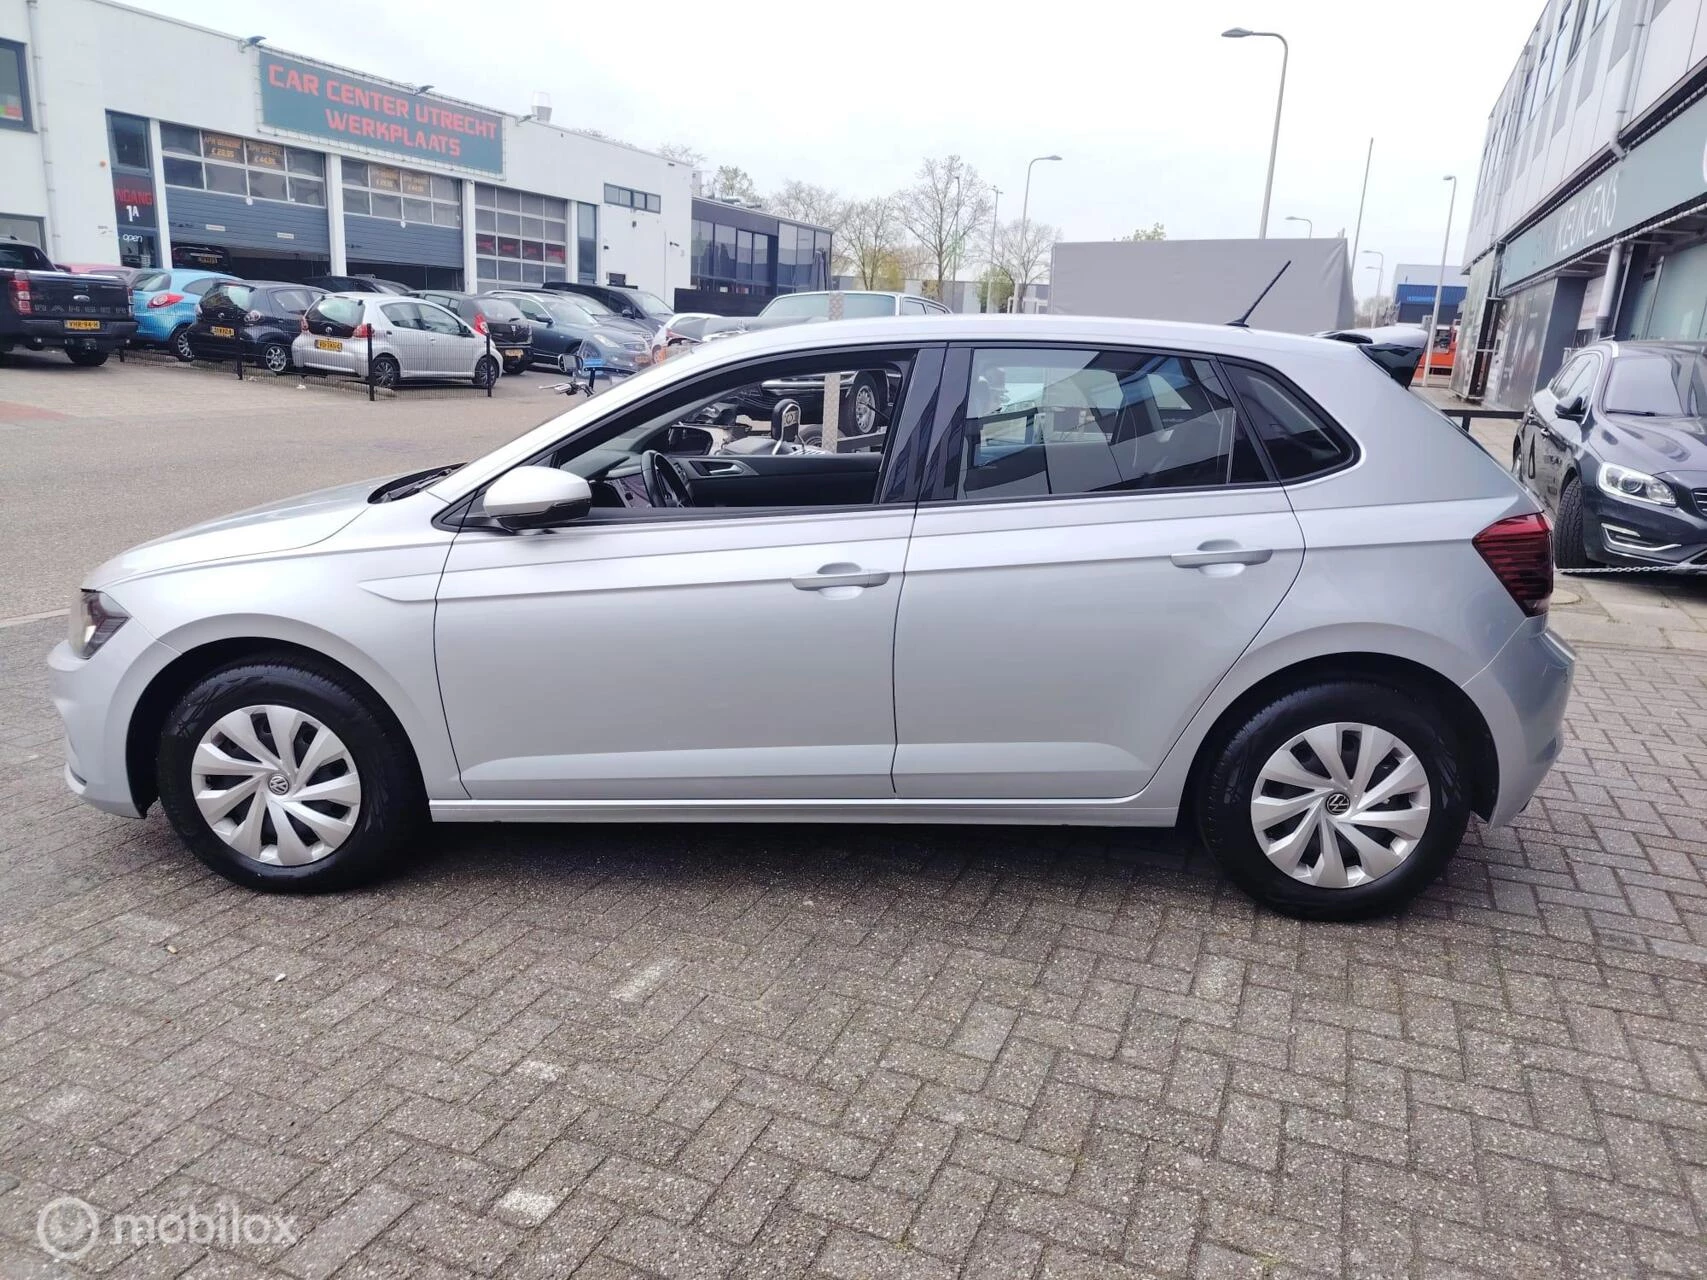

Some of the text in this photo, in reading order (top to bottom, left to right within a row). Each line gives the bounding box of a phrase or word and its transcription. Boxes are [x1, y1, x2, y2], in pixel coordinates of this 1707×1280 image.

[268, 63, 497, 140] CAR CENTER UTRECHT
[325, 108, 461, 157] WERKPLAATS
[114, 187, 153, 206] NGANG
[126, 204, 140, 222] 1A
[1555, 167, 1620, 256] KEUKENS
[122, 233, 143, 244] open
